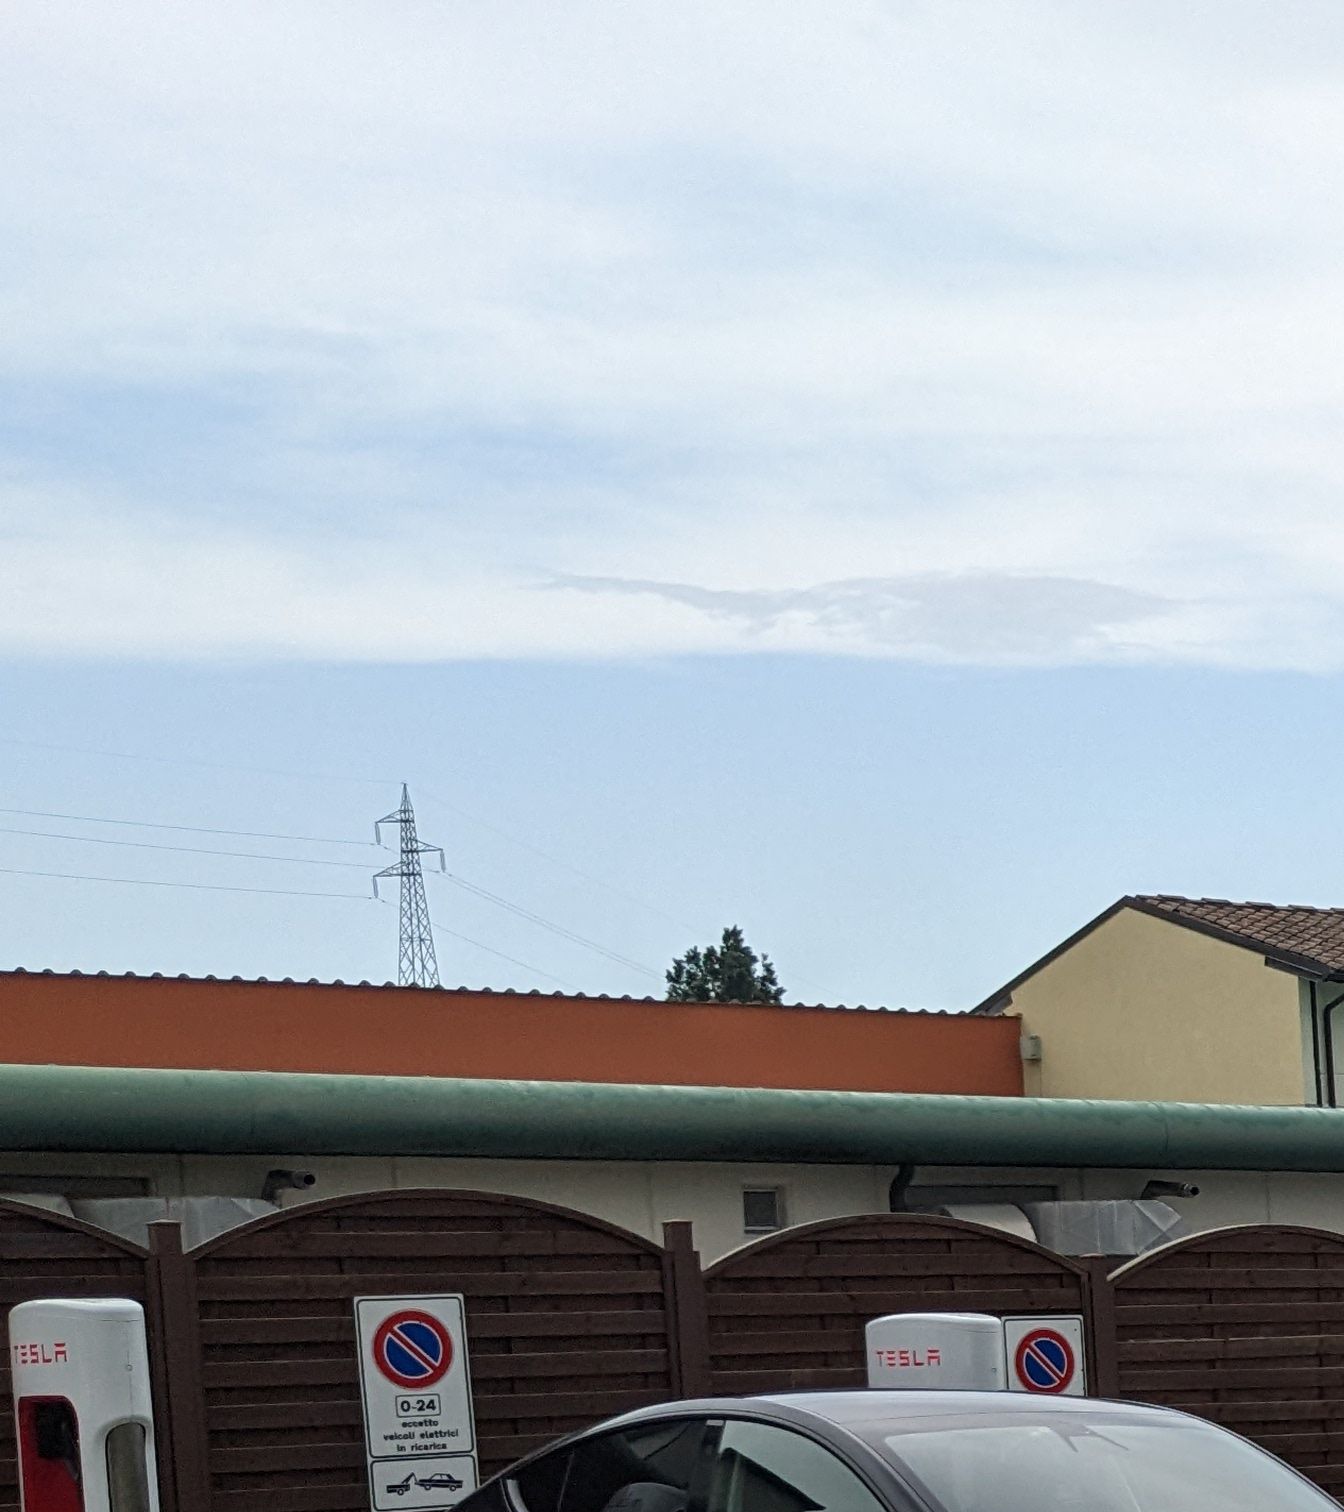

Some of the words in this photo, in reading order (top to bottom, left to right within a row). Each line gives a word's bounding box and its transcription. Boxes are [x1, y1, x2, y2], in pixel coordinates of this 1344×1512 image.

[876, 1349, 941, 1367] TESLA
[401, 1399, 436, 1412] 0-24
[401, 1418, 439, 1428] eccetto
[383, 1430, 415, 1442] veicoli
[419, 1428, 459, 1440] elettrici
[396, 1442, 407, 1452] in
[410, 1441, 448, 1452] ricarica
